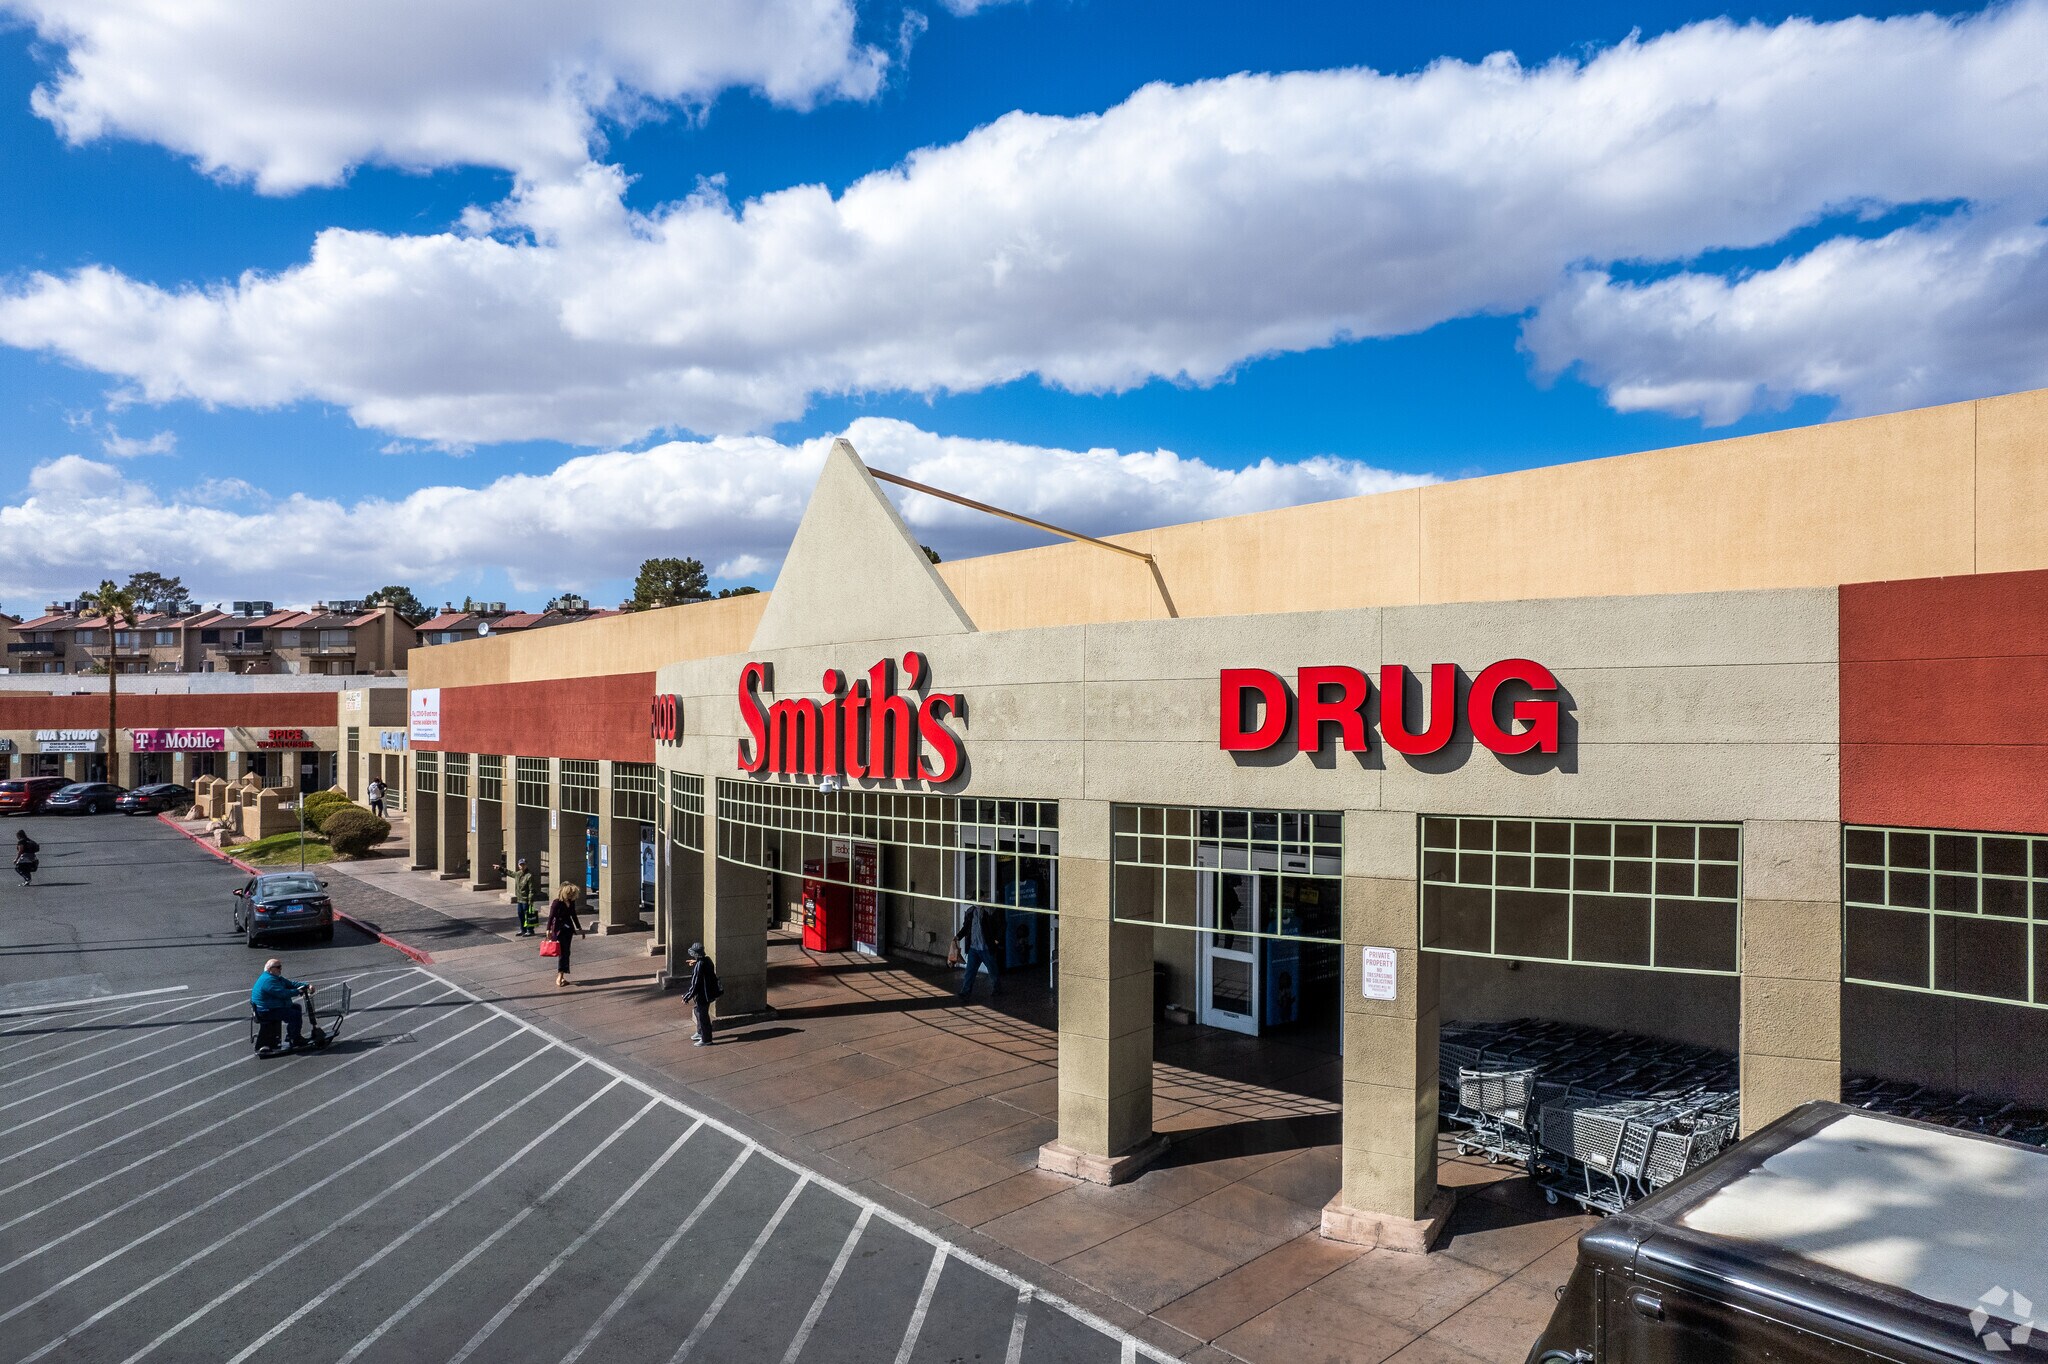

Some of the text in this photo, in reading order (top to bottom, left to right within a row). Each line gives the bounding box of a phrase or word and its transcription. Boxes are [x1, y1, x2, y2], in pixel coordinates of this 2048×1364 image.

[1220, 659, 1560, 755] DRUG
[738, 651, 965, 783] Smith's
[36, 730, 99, 740] AVA STUDIO
[268, 729, 303, 740] SPICE
[1369, 951, 1390, 959] PRIVATE
[1366, 959, 1393, 967] PROPERTY
